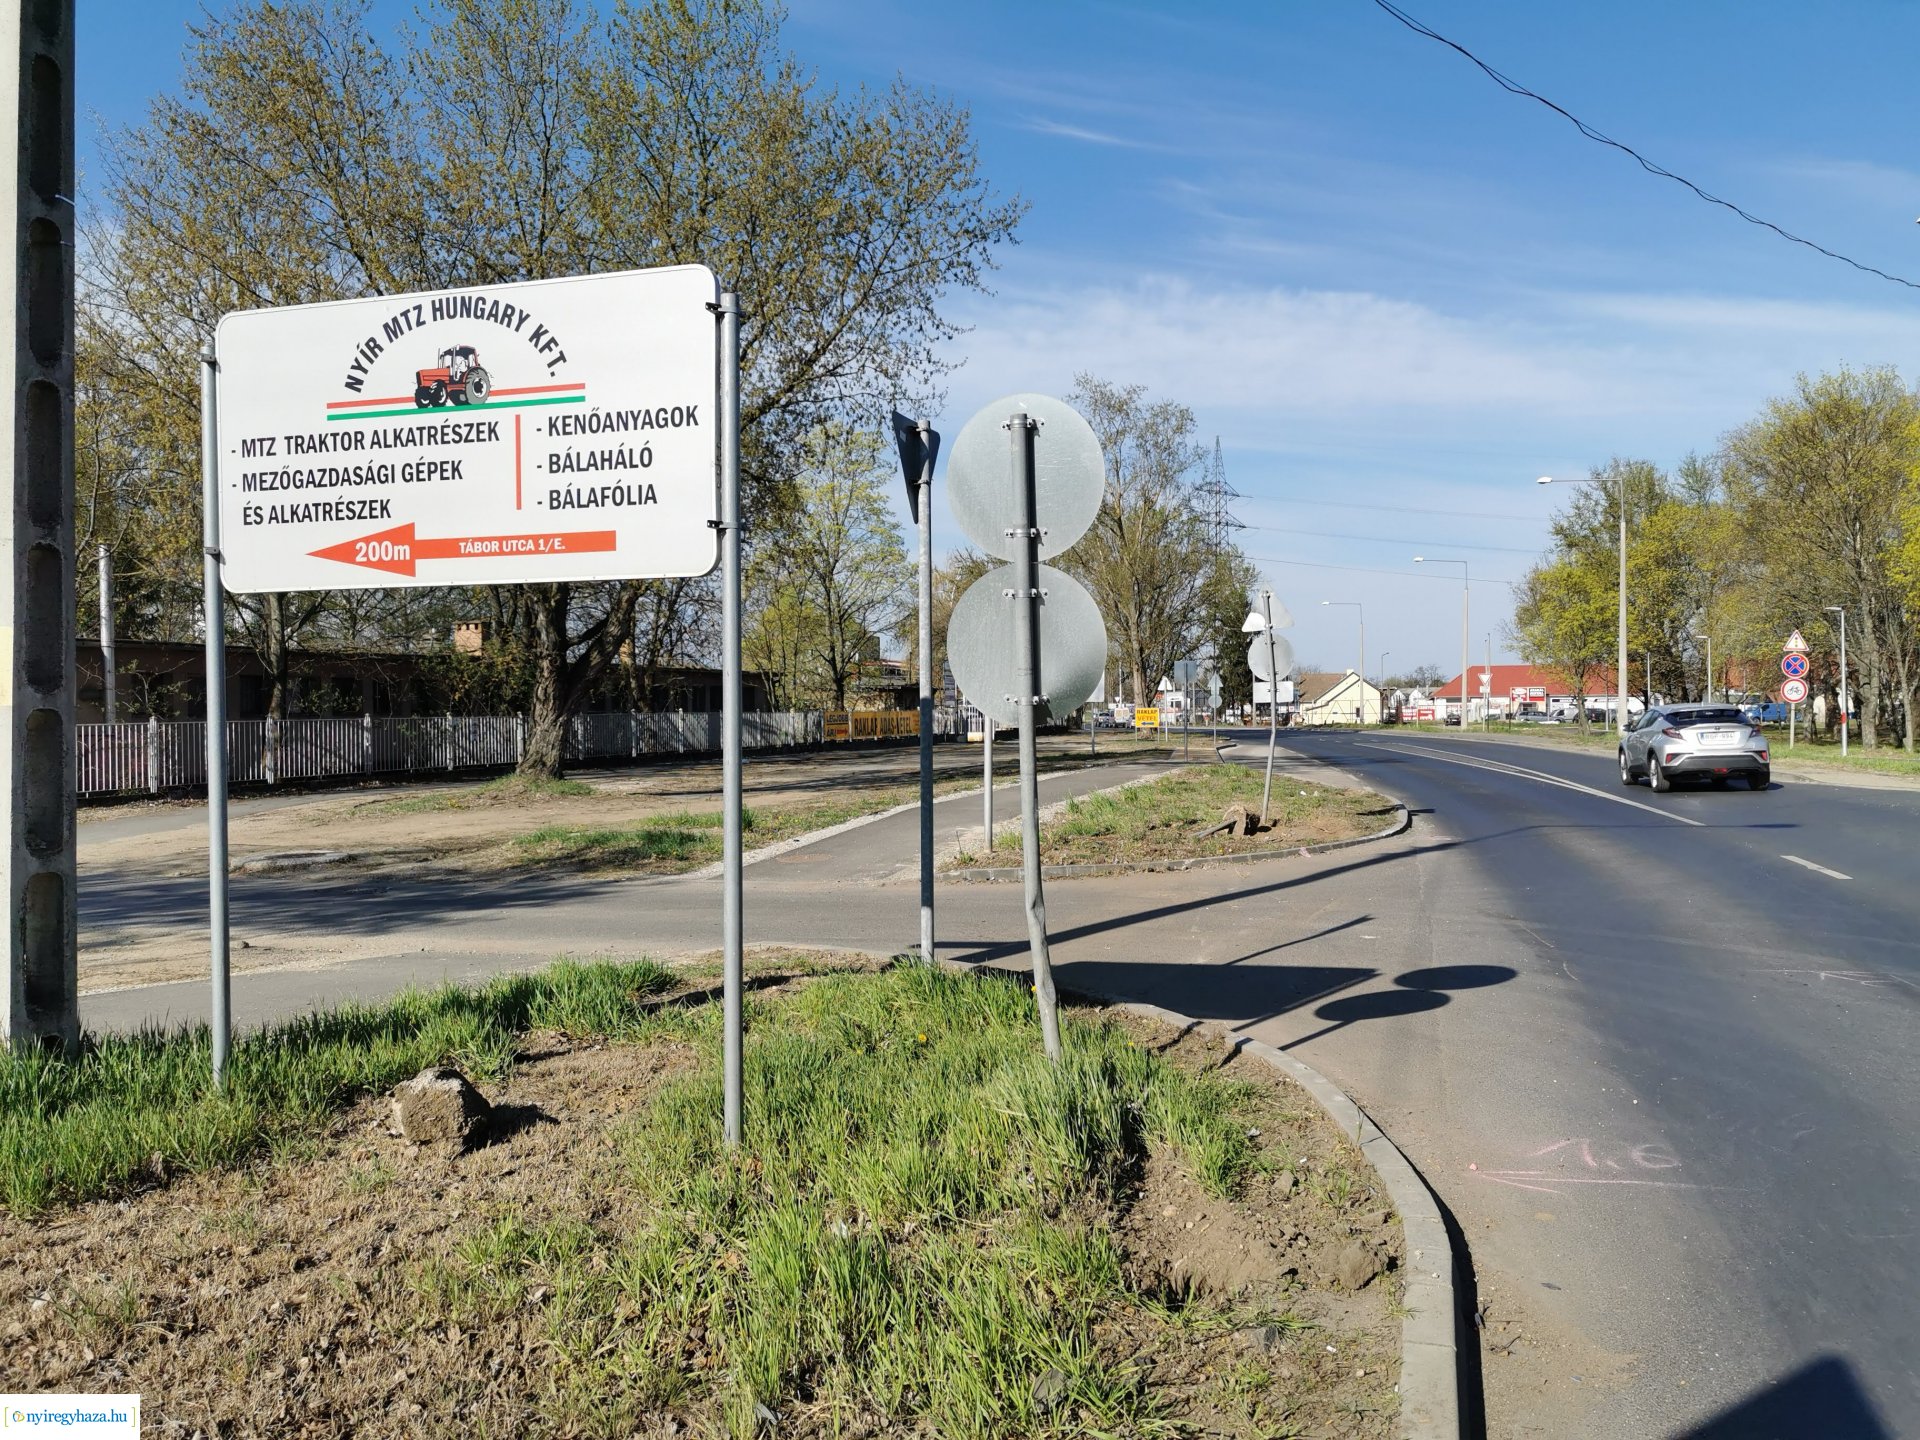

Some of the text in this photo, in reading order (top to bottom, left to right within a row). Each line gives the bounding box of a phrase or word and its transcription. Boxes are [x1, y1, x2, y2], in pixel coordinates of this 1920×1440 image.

[345, 296, 566, 392] NYÍR MTZ HUNGARY KFT.
[547, 403, 698, 436] KENŐANYAGOK
[242, 437, 276, 458] MTZ
[284, 431, 365, 454] TRAKTOR
[370, 419, 499, 449] ALKATRÉSZEK
[549, 441, 652, 473] BÁLAHÁLÓ
[243, 466, 395, 492] MEZŐGAZDASÁGI
[402, 456, 462, 482] GÉPEK
[244, 496, 391, 525] ÉS ALKATRÉSZEK
[550, 480, 657, 510] BÁLAFÓLIA
[355, 540, 411, 562] 200m
[459, 537, 566, 554] TÁBOR UTCA 1/E.
